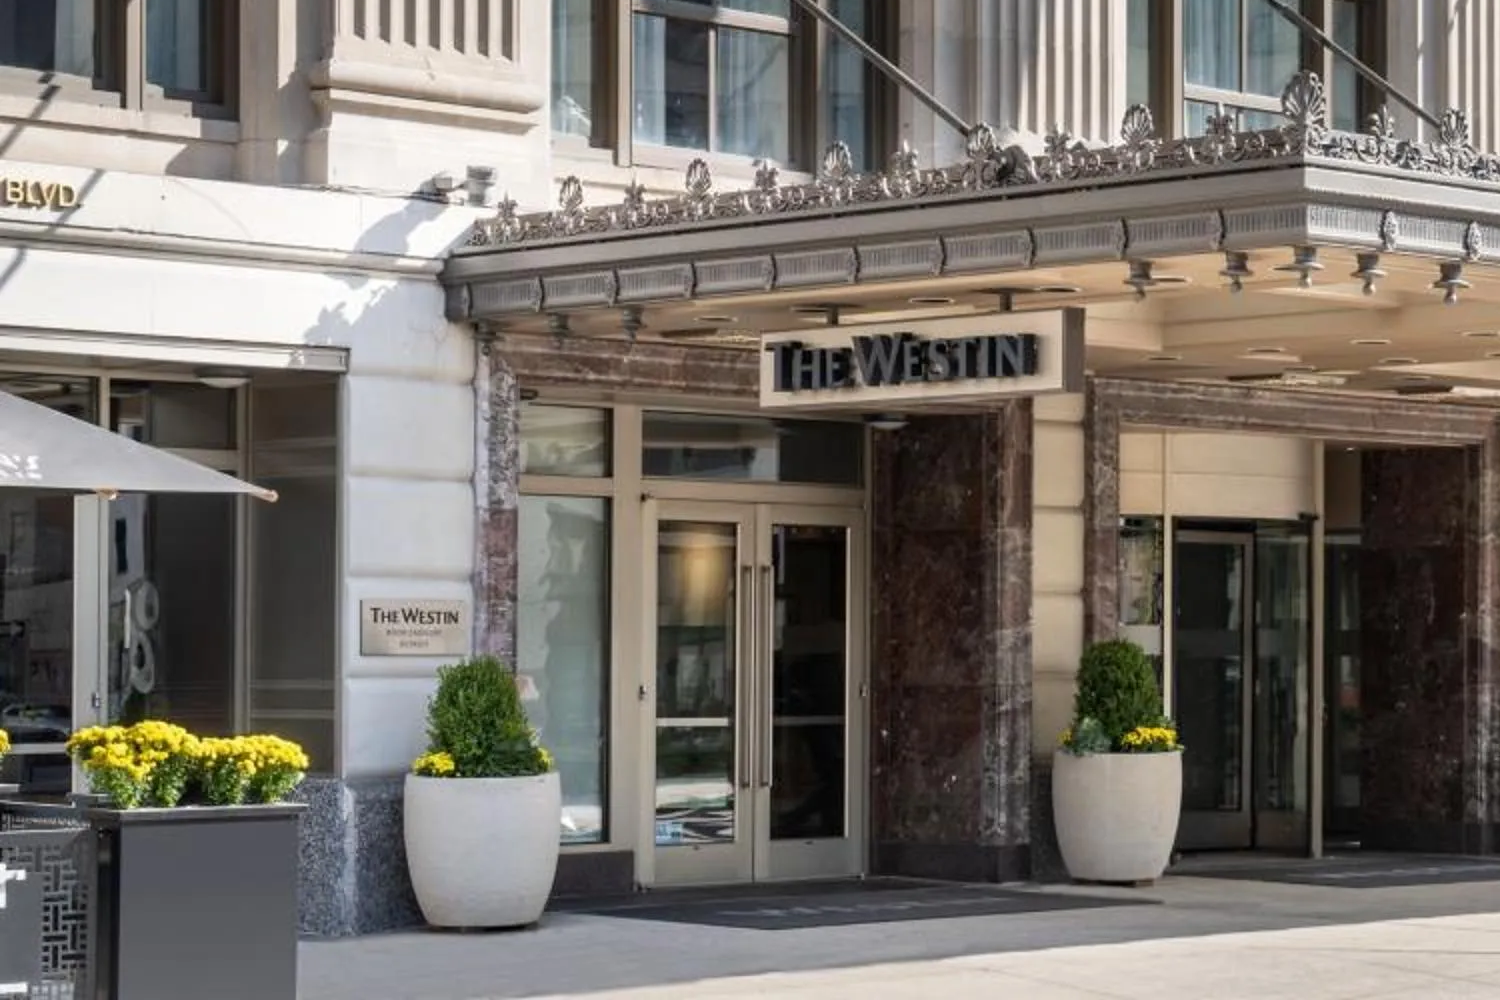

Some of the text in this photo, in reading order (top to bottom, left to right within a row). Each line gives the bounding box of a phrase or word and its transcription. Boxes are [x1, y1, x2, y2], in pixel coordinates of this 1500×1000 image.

[5, 178, 78, 209] BLVD
[766, 332, 1041, 391] THE WESTIN
[370, 607, 459, 625] THE WESTIN
